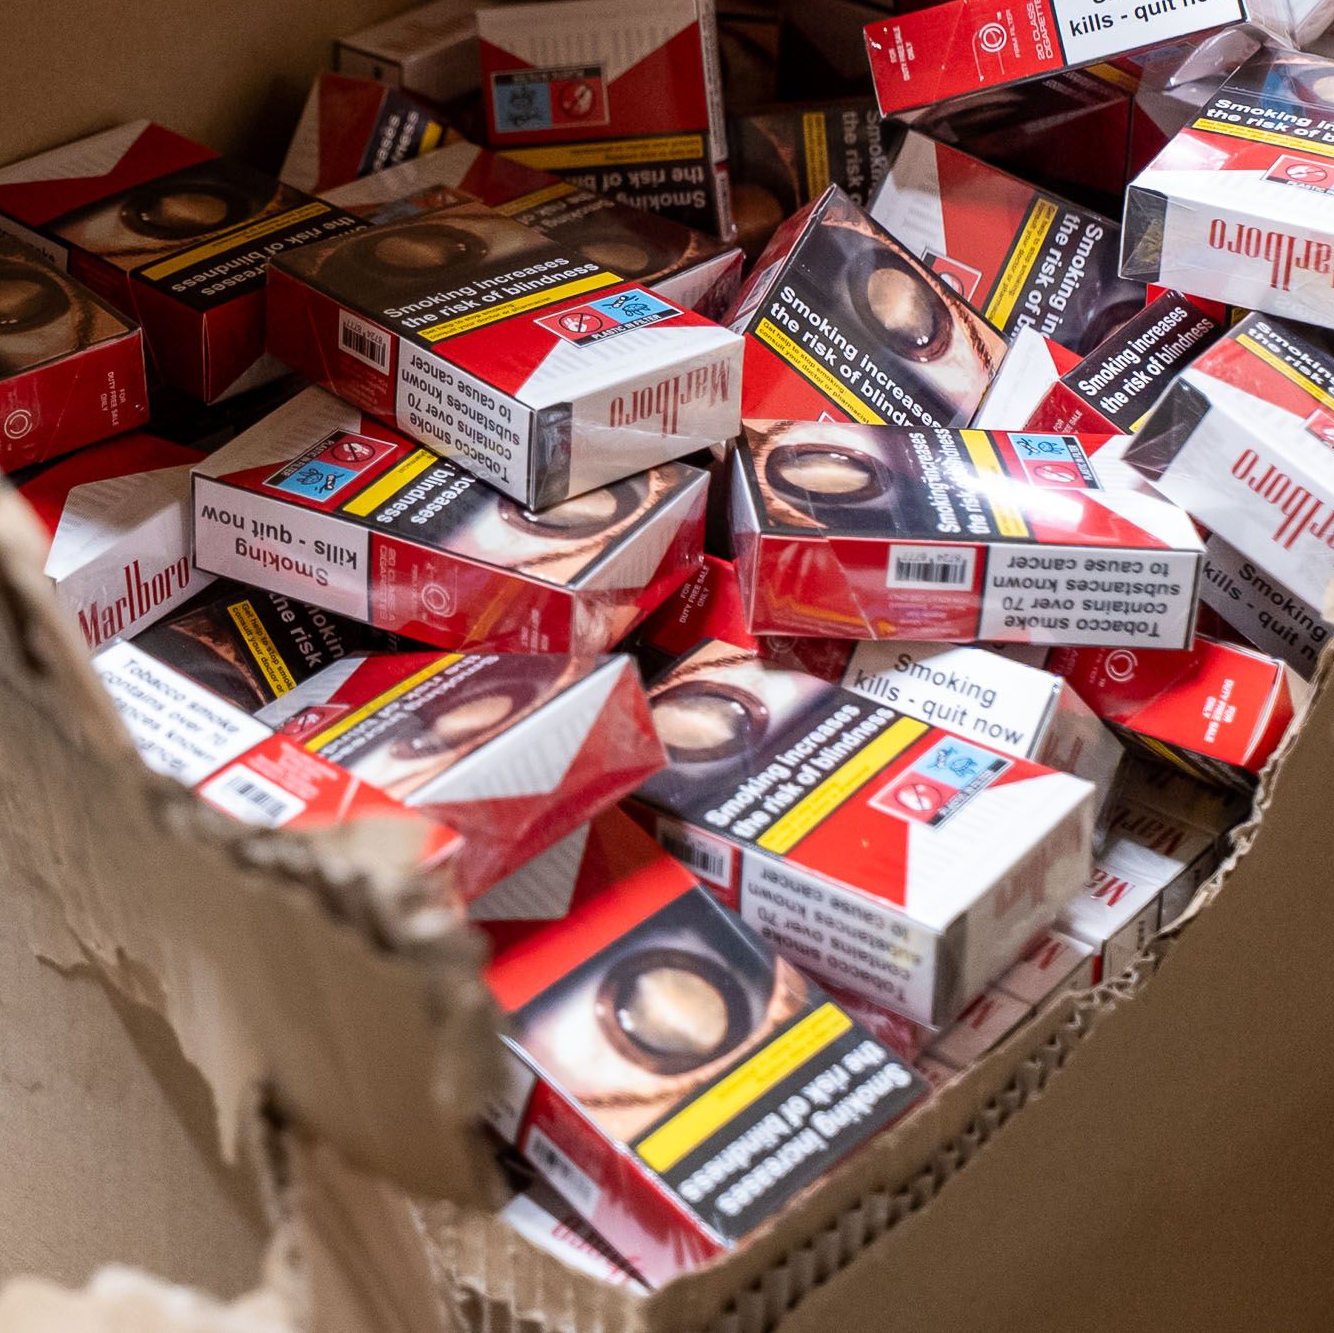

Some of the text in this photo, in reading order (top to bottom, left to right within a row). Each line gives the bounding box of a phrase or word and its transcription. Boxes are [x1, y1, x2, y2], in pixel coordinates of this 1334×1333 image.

[1026, 5, 1041, 43] CLASS
[1069, 14, 1113, 37] kills
[1207, 108, 1245, 125] the
[1251, 116, 1290, 136] risk
[1296, 126, 1319, 140] of
[1214, 99, 1301, 129] Smoking
[171, 227, 326, 293] risk blindness
[383, 257, 569, 320] Smoking increases
[1025, 214, 1080, 315] the risk of
[1049, 224, 1103, 312] Smoking
[401, 263, 598, 328] the risk of blindness
[591, 314, 661, 340] PLASTIC FILTER
[759, 328, 823, 383] consult your doctor
[762, 321, 816, 368] Get help stop
[769, 302, 861, 387] the risk of
[779, 287, 946, 431] Smoking increases
[1078, 306, 1188, 396] Smoking increases
[1100, 317, 1213, 415] the risk of blindness
[1248, 328, 1280, 354] the
[1285, 355, 1325, 386] risk
[401, 368, 520, 446] substances known
[410, 354, 512, 421] to cause cancer
[610, 358, 730, 435] Marlboro
[407, 393, 512, 462] contains over 70
[410, 415, 510, 484] Tobacco smoke
[376, 469, 454, 524] blindness
[909, 432, 961, 534] Smoking increases
[202, 505, 357, 568] kills quit now
[235, 538, 329, 586] Smoking
[1008, 554, 1169, 577] to cause cancer
[78, 555, 191, 648] Marlboro
[679, 585, 701, 623] DUTY FREE
[680, 583, 691, 598] FOR
[697, 587, 709, 607] ONLY
[994, 577, 1180, 596] substances known
[1003, 597, 1166, 614] contains over 70
[1202, 560, 1299, 654] kills quit
[1239, 563, 1328, 642] Smoking
[291, 626, 322, 668] risk
[1005, 616, 1161, 637] Tobacco smoke
[853, 668, 1025, 747] kills quit now
[894, 653, 997, 707] Smoking
[704, 703, 861, 827] Smoking increases
[731, 707, 895, 838] the risk of blindness
[678, 1040, 887, 1202] the risk of blindness
[715, 1062, 912, 1215] Smoking increases
